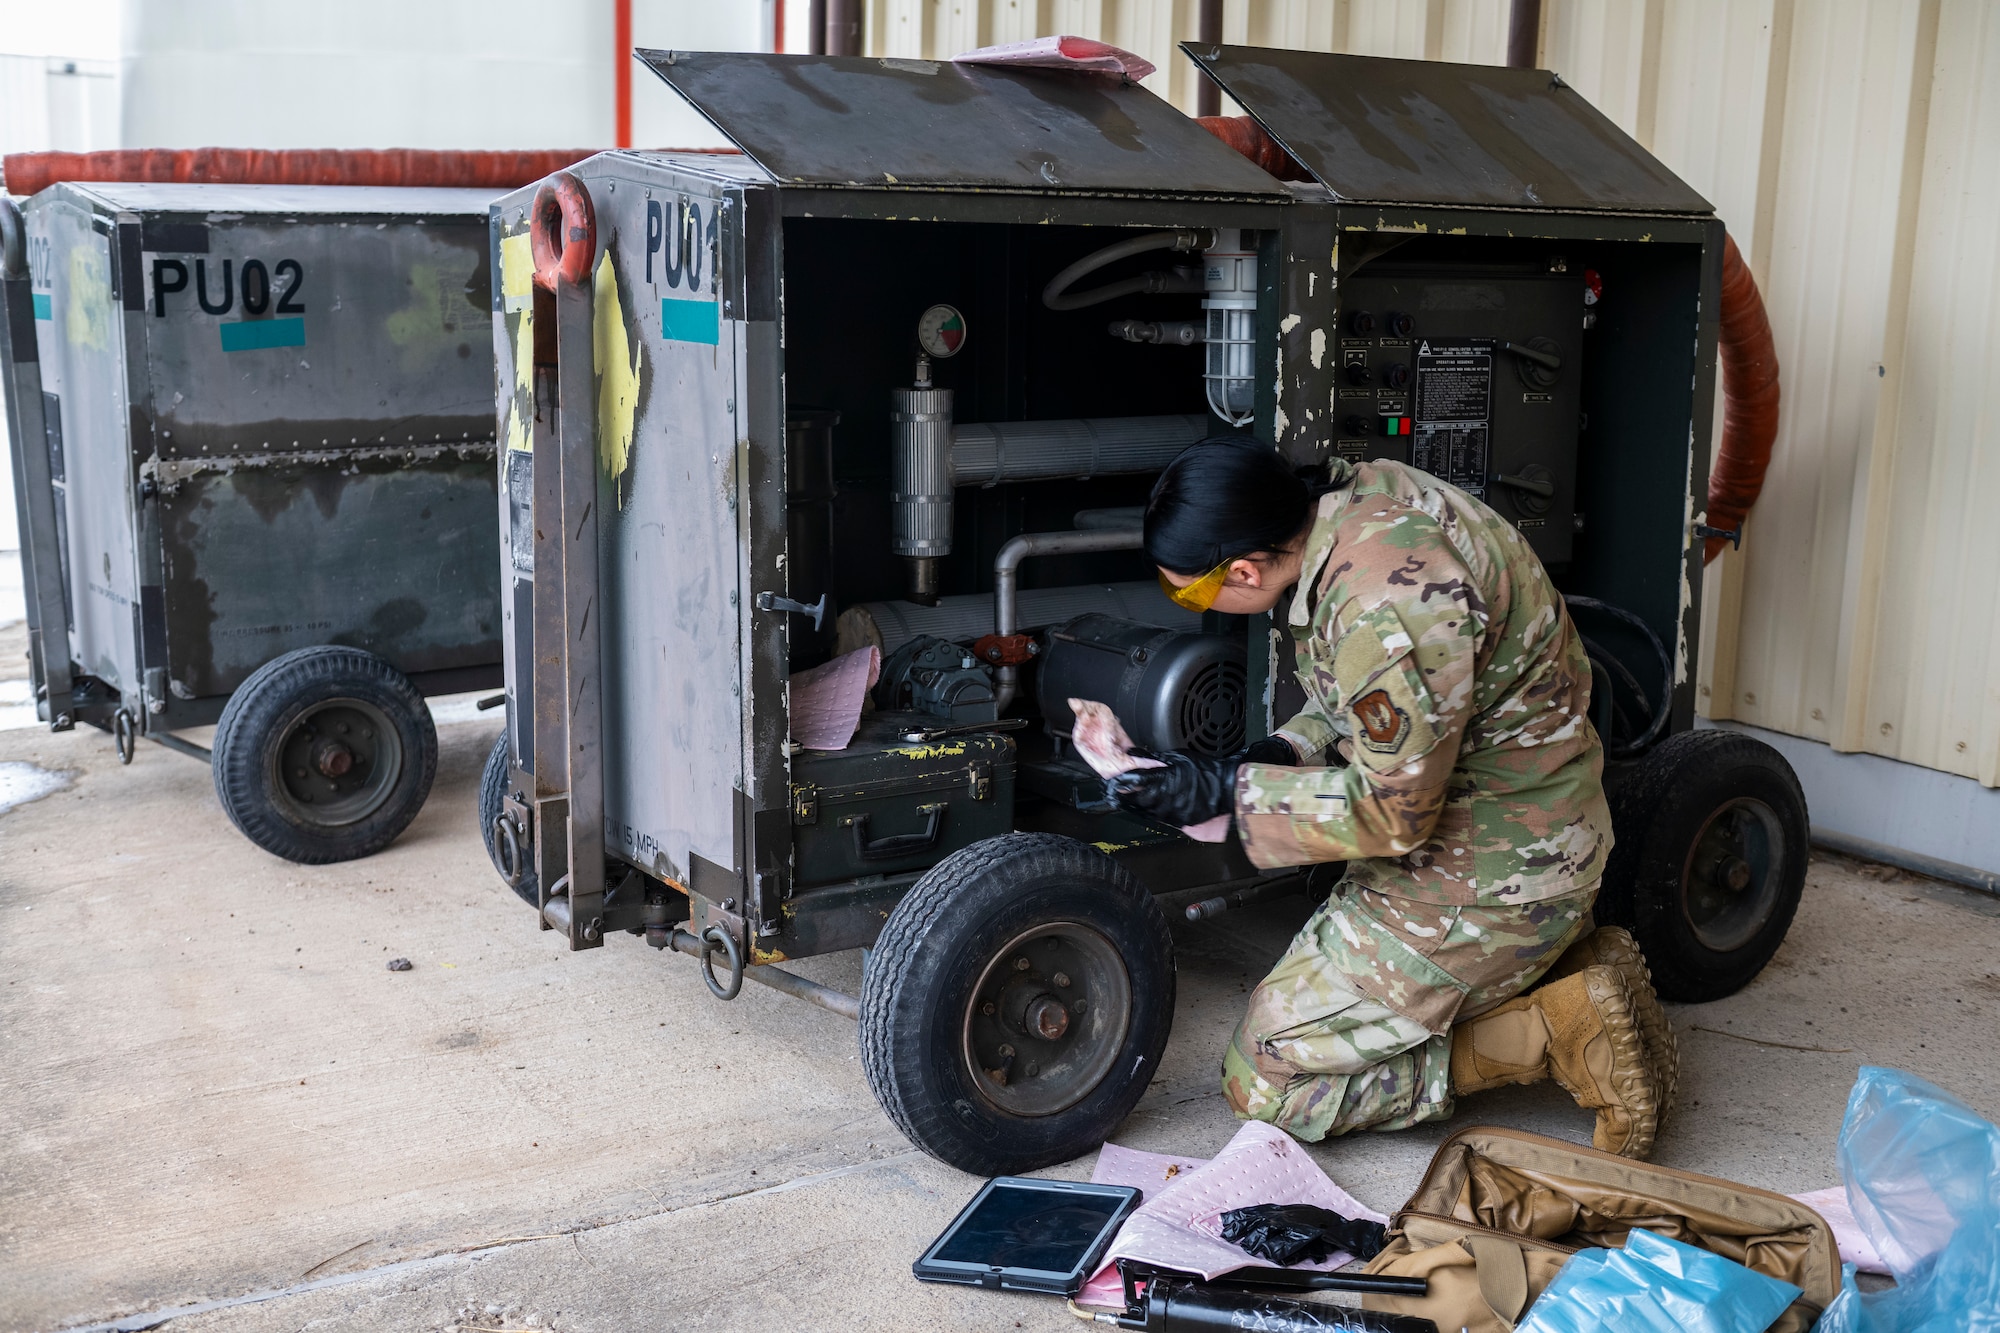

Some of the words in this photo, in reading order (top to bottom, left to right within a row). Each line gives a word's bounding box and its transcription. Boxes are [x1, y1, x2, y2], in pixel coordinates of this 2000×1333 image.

[646, 200, 719, 294] PU01
[152, 258, 306, 318] PU02
[605, 817, 620, 839] OW
[623, 823, 633, 846] 15
[636, 830, 659, 859] MPH
